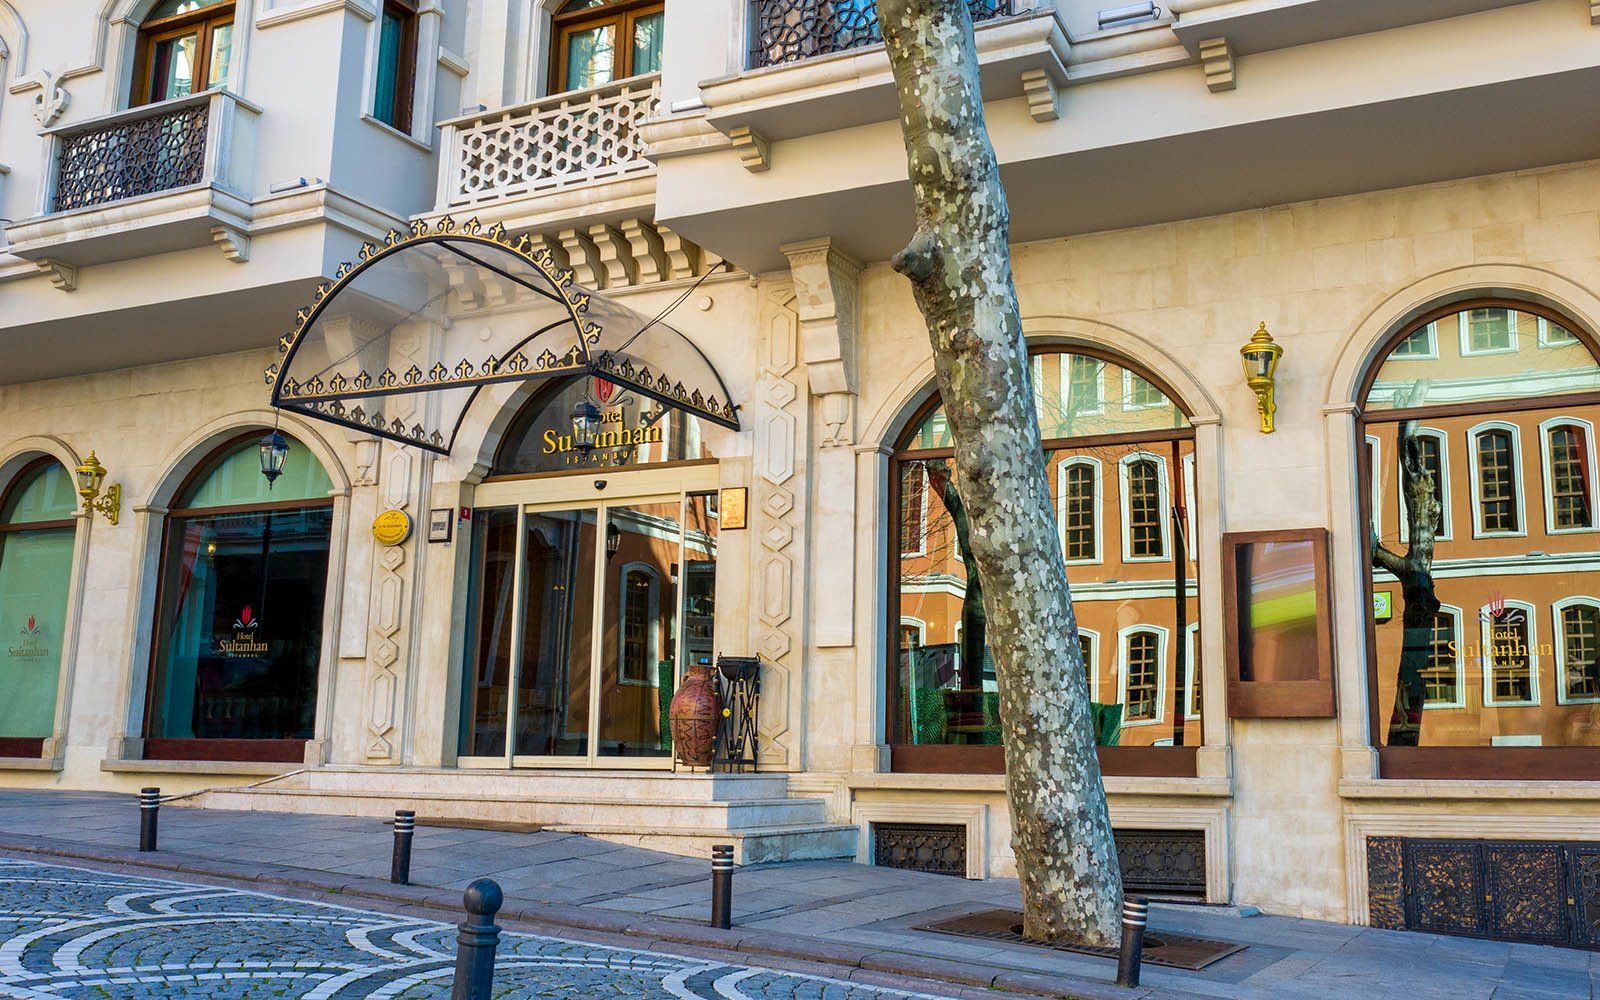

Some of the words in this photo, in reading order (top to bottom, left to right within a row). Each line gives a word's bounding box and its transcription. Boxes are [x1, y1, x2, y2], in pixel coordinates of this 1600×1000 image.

[542, 421, 663, 454] Sulanhan
[566, 450, 638, 465] ISANBUL
[219, 639, 269, 653] Sultanhan
